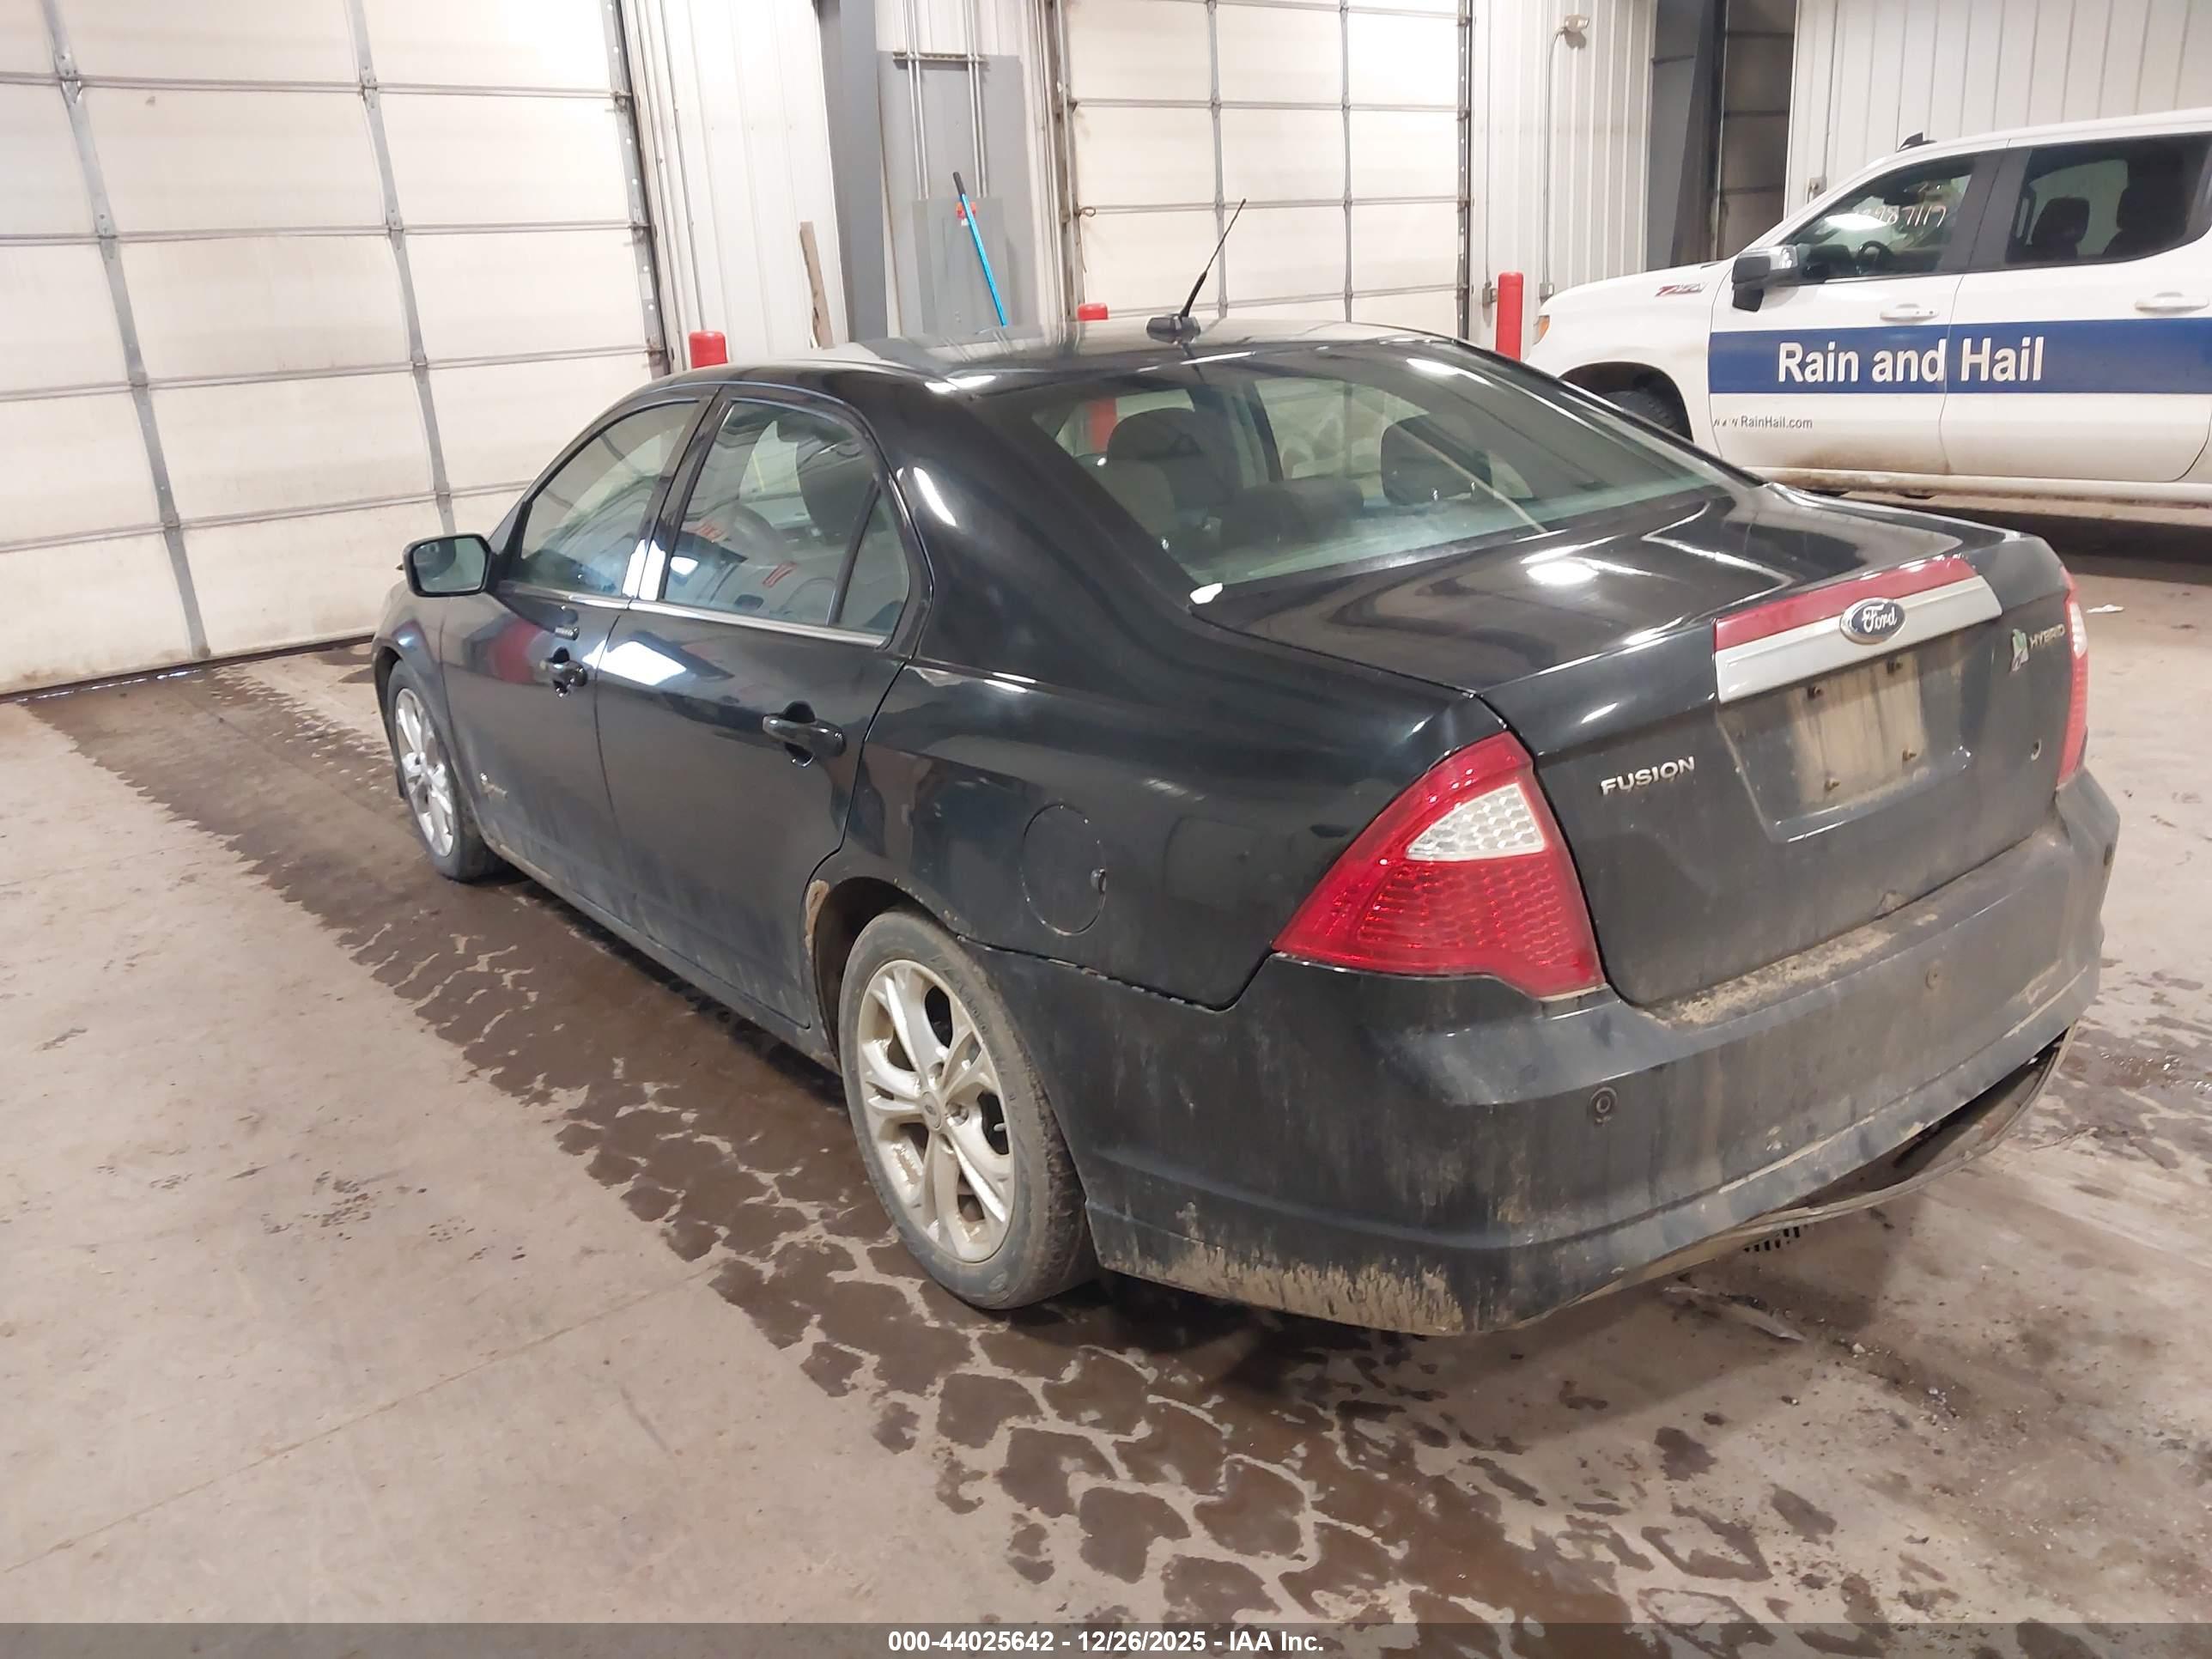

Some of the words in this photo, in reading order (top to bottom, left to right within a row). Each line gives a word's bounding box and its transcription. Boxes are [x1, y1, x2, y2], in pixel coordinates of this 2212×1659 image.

[1778, 341, 1859, 383] Rain
[1871, 337, 1948, 383] and
[1960, 336, 2045, 382] Hail
[1862, 604, 1898, 633] Ford
[1601, 756, 1695, 795] FUSION
